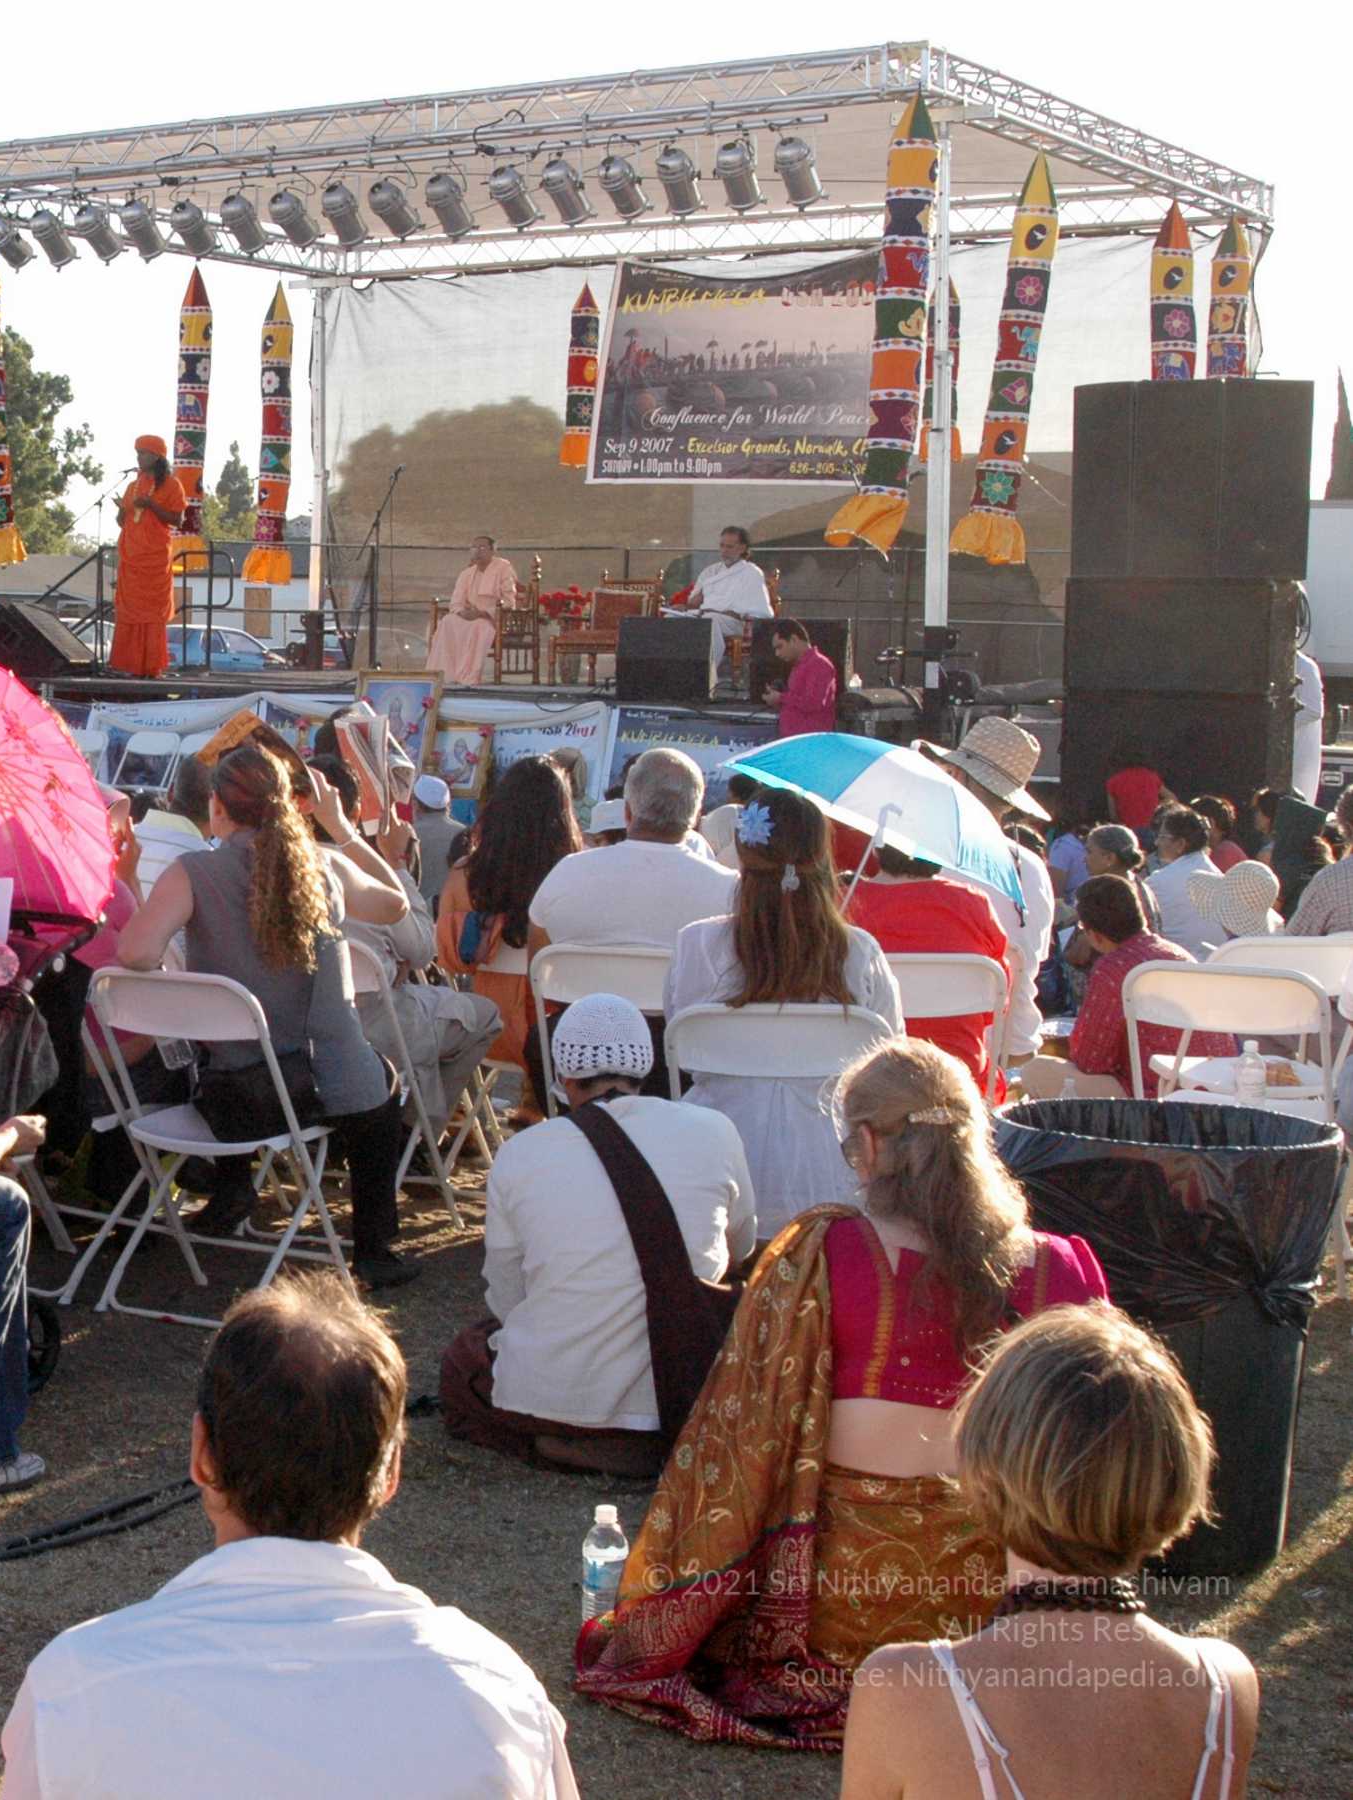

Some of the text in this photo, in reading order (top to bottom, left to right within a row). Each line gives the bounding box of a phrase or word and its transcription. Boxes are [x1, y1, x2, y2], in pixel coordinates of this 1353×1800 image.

[648, 405, 726, 432] Confluence
[721, 405, 752, 432] for
[759, 404, 816, 425] World
[604, 438, 626, 457] Sep
[628, 438, 638, 453] 9
[640, 437, 674, 453] 2007
[687, 437, 737, 454] Excelsior
[741, 437, 790, 457] Grounds,
[674, 458, 685, 473] to
[686, 457, 722, 477] 9:00pm
